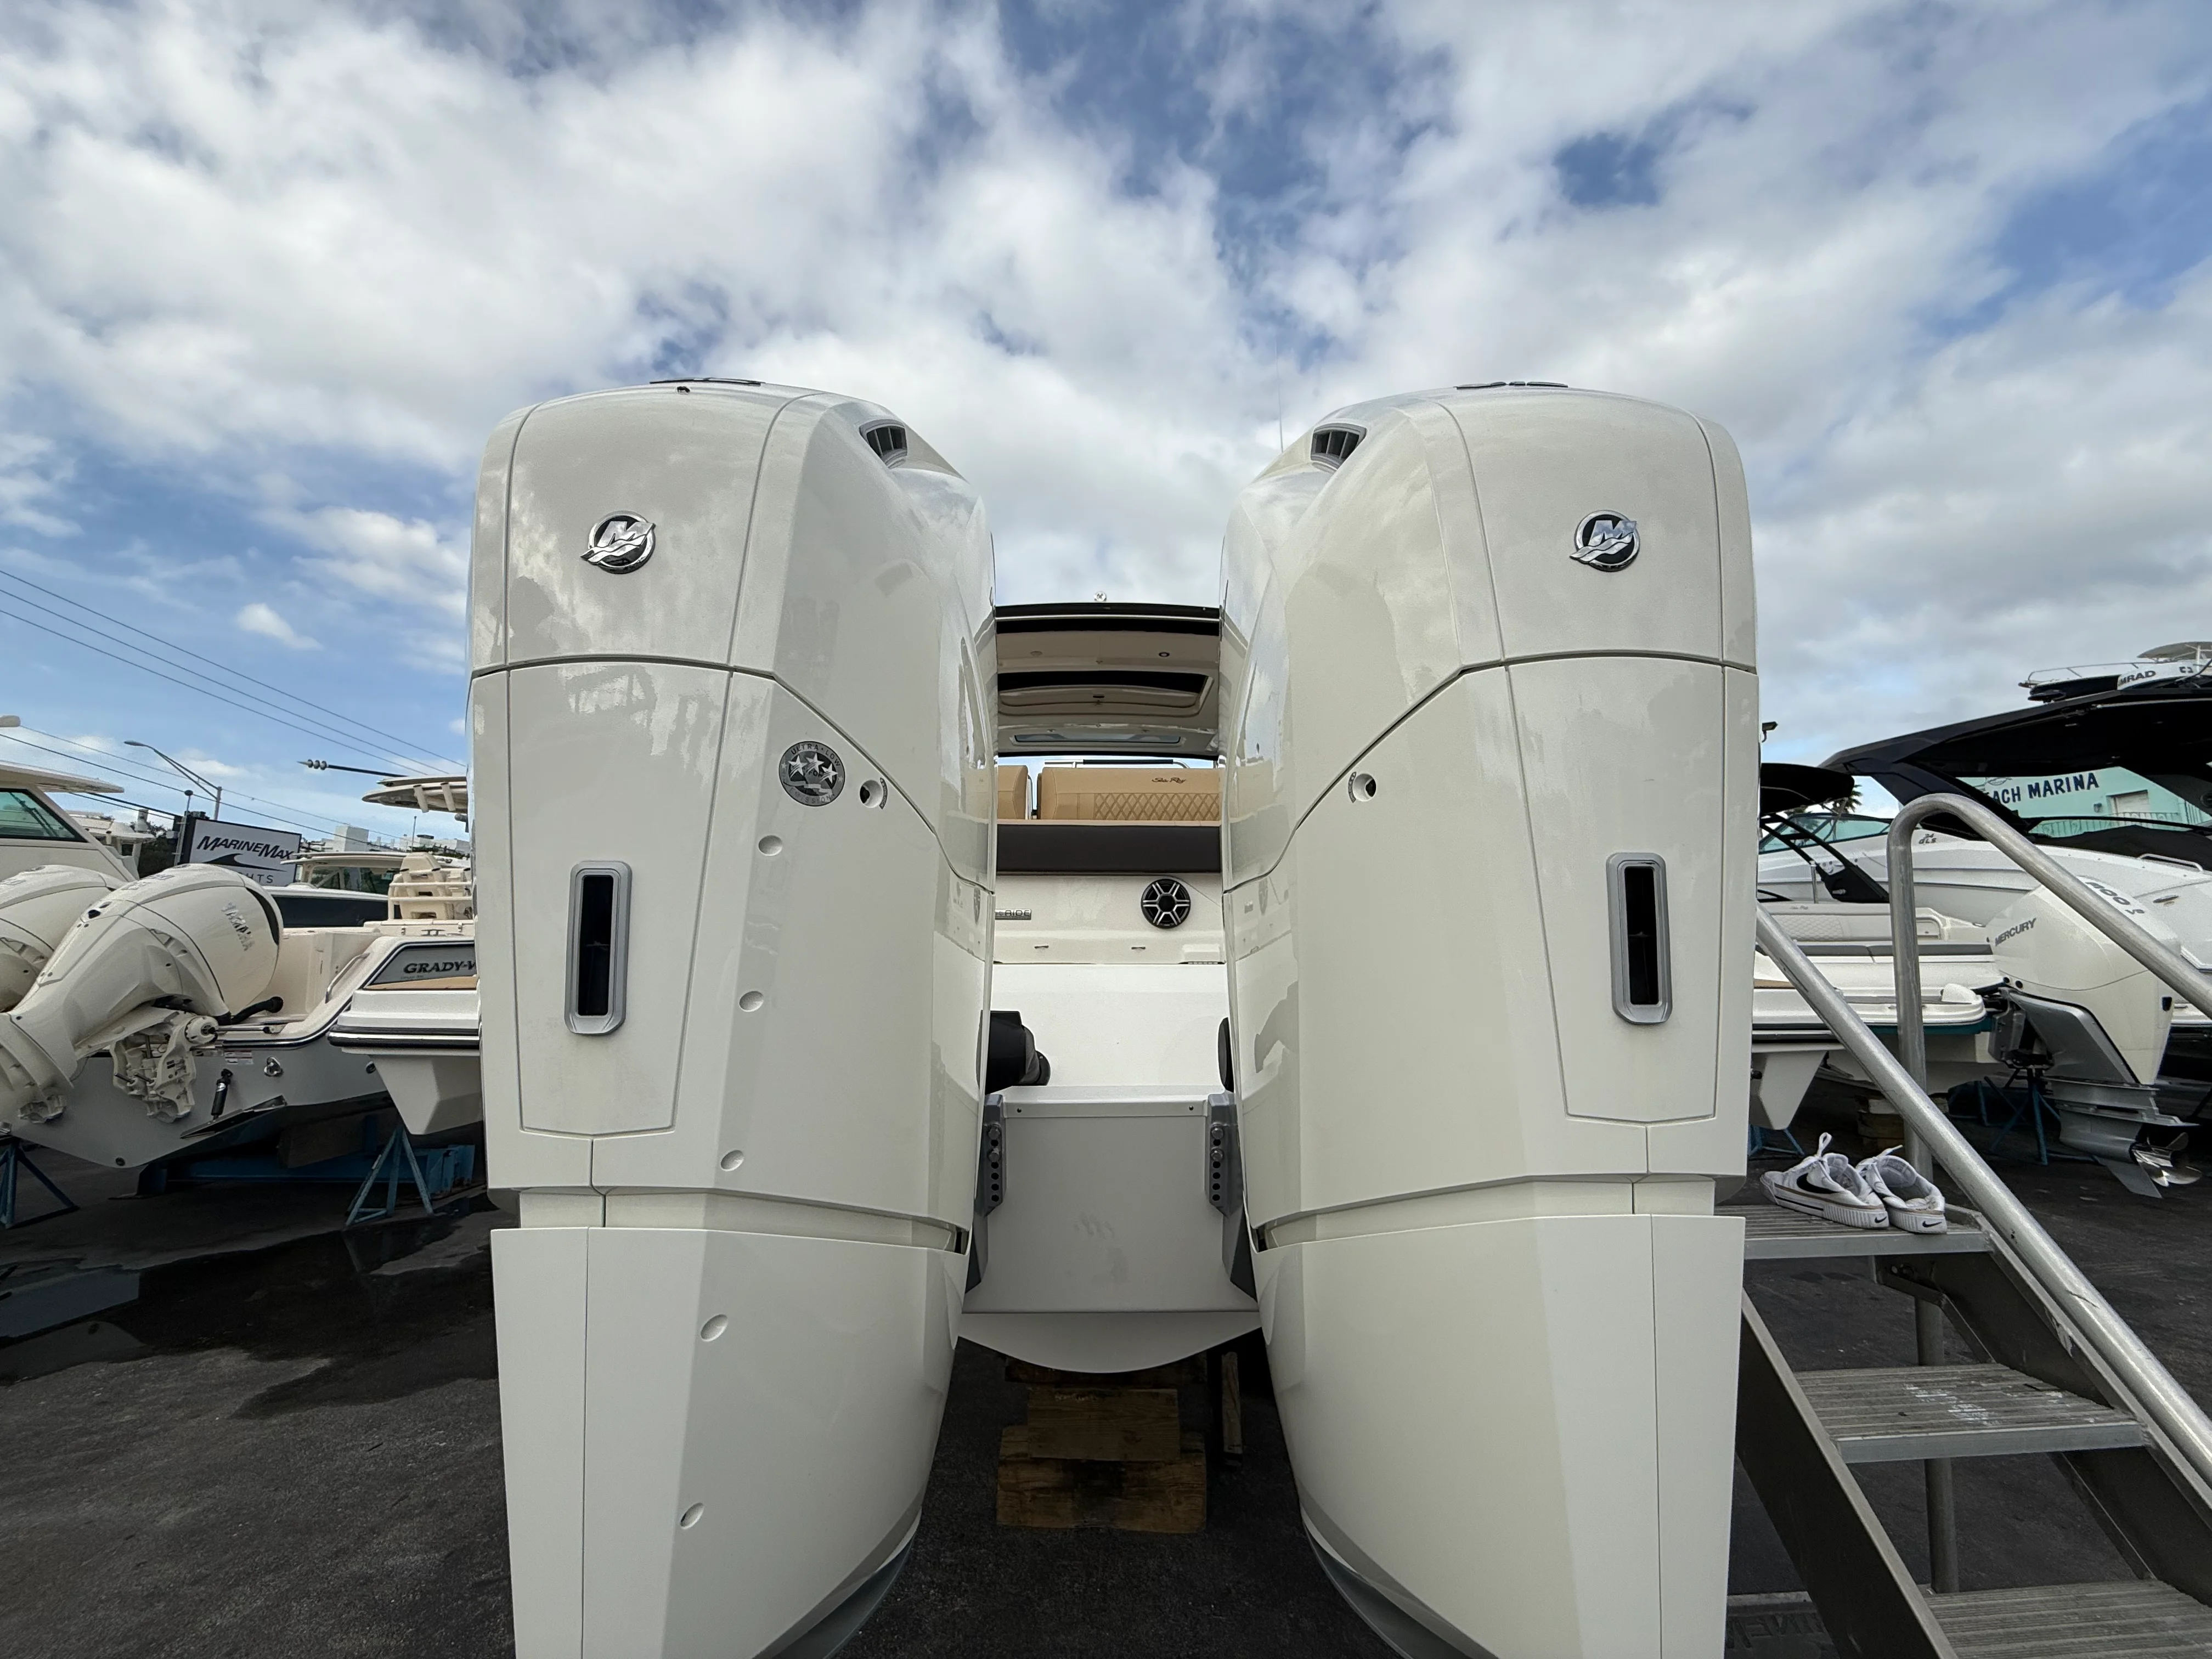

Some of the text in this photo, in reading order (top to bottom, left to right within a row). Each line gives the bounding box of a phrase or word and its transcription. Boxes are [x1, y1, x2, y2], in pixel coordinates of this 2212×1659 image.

[825, 749, 841, 766] LOW
[1986, 772, 2100, 804] ACH MARINA
[238, 872, 274, 884] HTS
[1995, 918, 2036, 946] MERCURY
